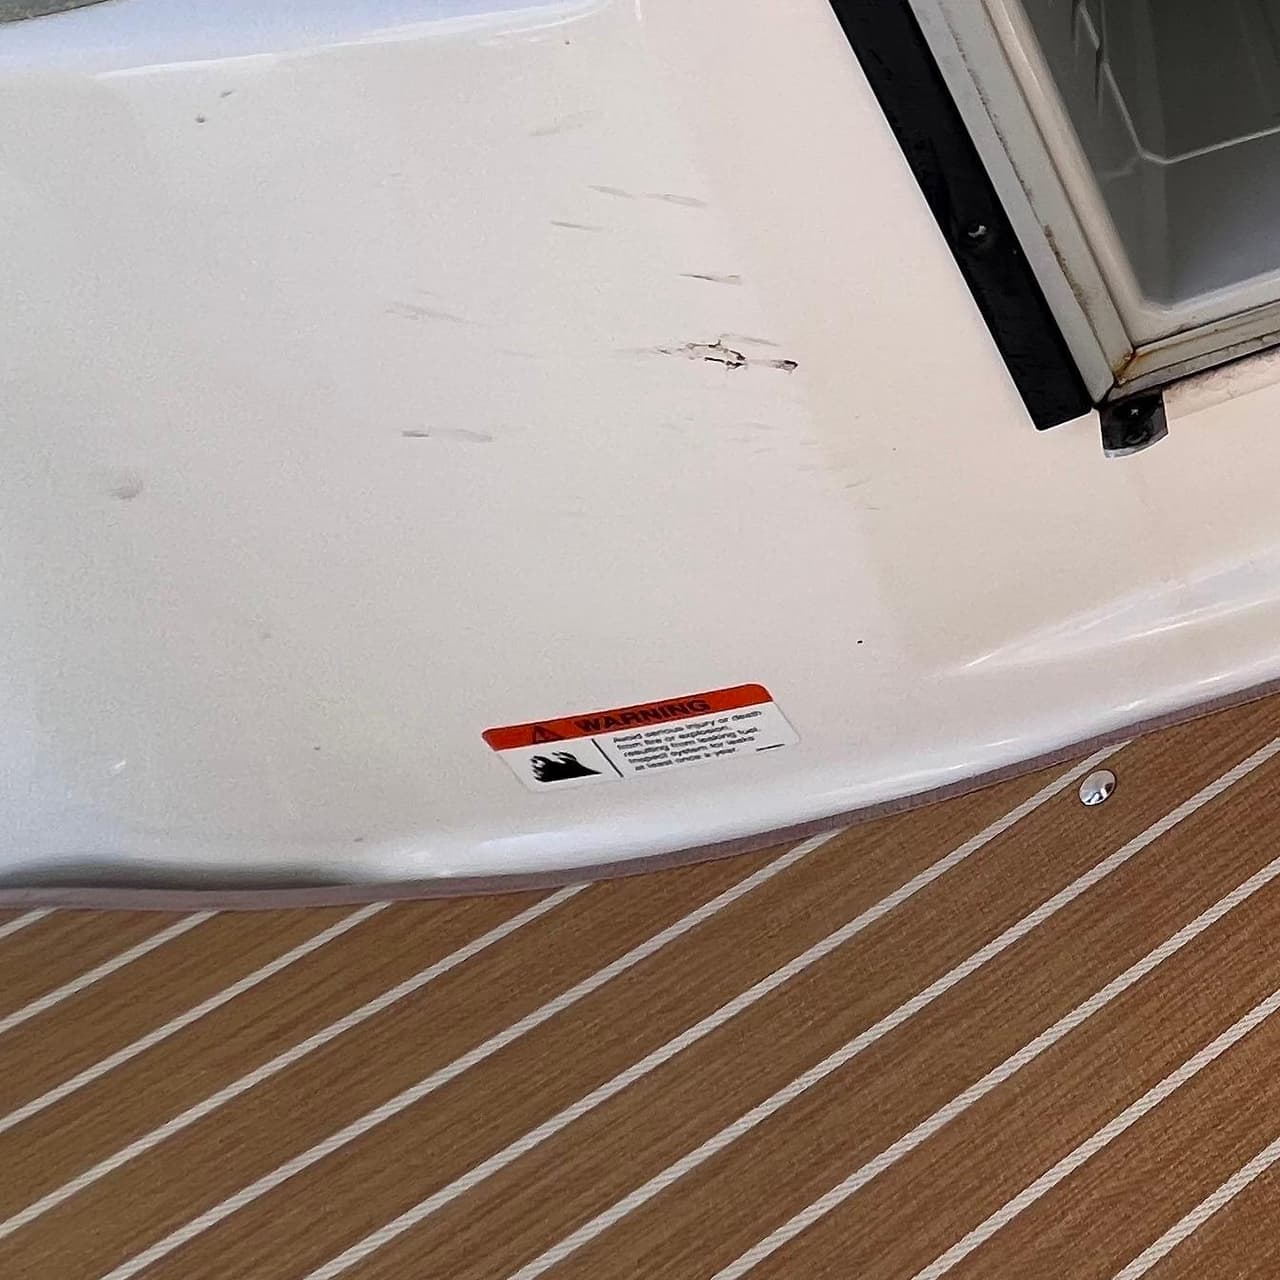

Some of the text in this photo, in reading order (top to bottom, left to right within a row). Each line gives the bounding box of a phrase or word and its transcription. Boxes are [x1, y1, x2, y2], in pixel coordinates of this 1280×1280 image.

[574, 699, 711, 733] WARNING
[644, 726, 684, 738] serious
[685, 720, 716, 730] injury
[731, 710, 762, 721] death
[616, 742, 644, 750] from
[623, 744, 670, 758] resulting
[670, 738, 696, 748] from
[696, 731, 737, 743] leaking
[628, 735, 755, 764] Inspect system for leaks
[646, 758, 673, 769] least
[674, 754, 701, 763] once
